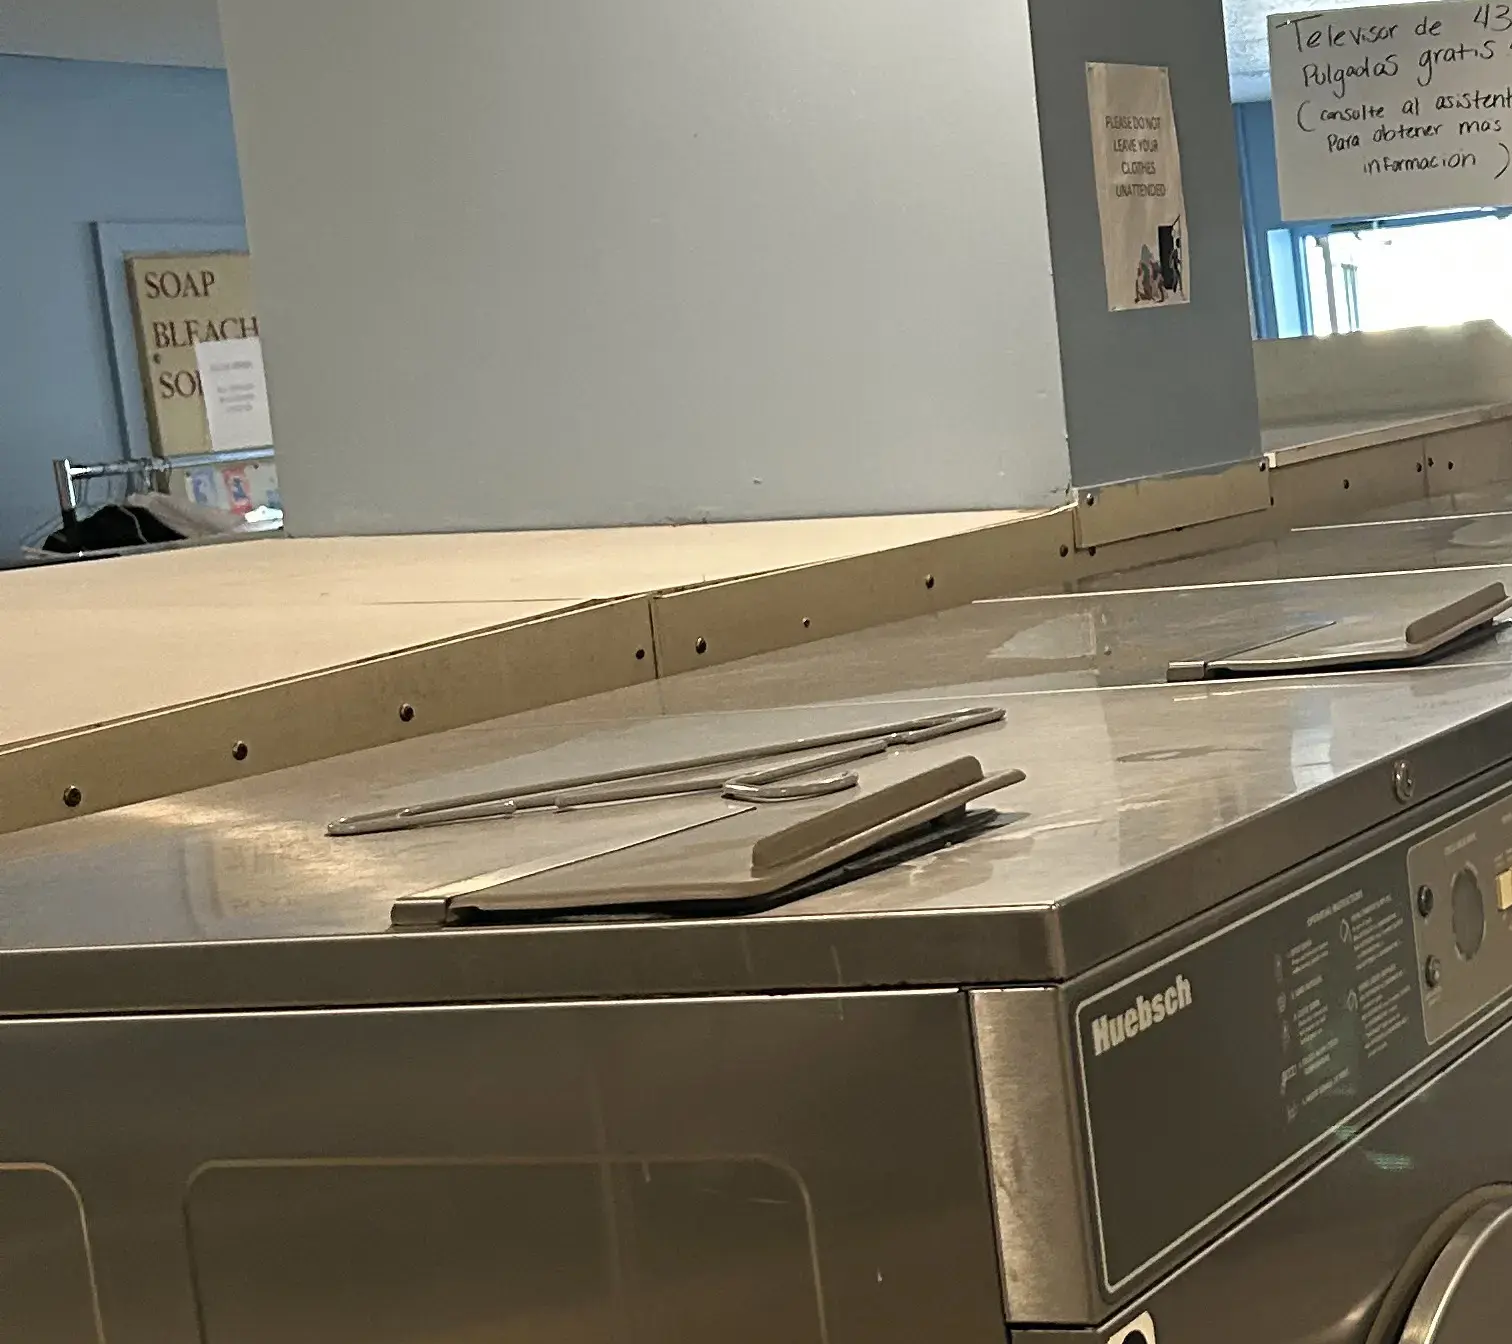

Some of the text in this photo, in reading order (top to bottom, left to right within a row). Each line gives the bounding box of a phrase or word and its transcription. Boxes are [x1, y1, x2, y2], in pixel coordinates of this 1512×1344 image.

[1276, 3, 1512, 53] Televisor de 43
[1402, 96, 1420, 116] al
[1105, 115, 1161, 131] PLEASE DO NOT
[1372, 123, 1443, 143] obtener
[1113, 138, 1159, 153] LEAVE YOUR
[1121, 161, 1157, 175] CLOTHES
[1115, 183, 1167, 198] UNATTENDED
[144, 269, 216, 299] SOAP
[152, 316, 260, 349] BLEACH
[1091, 973, 1193, 1057] Huebsch
